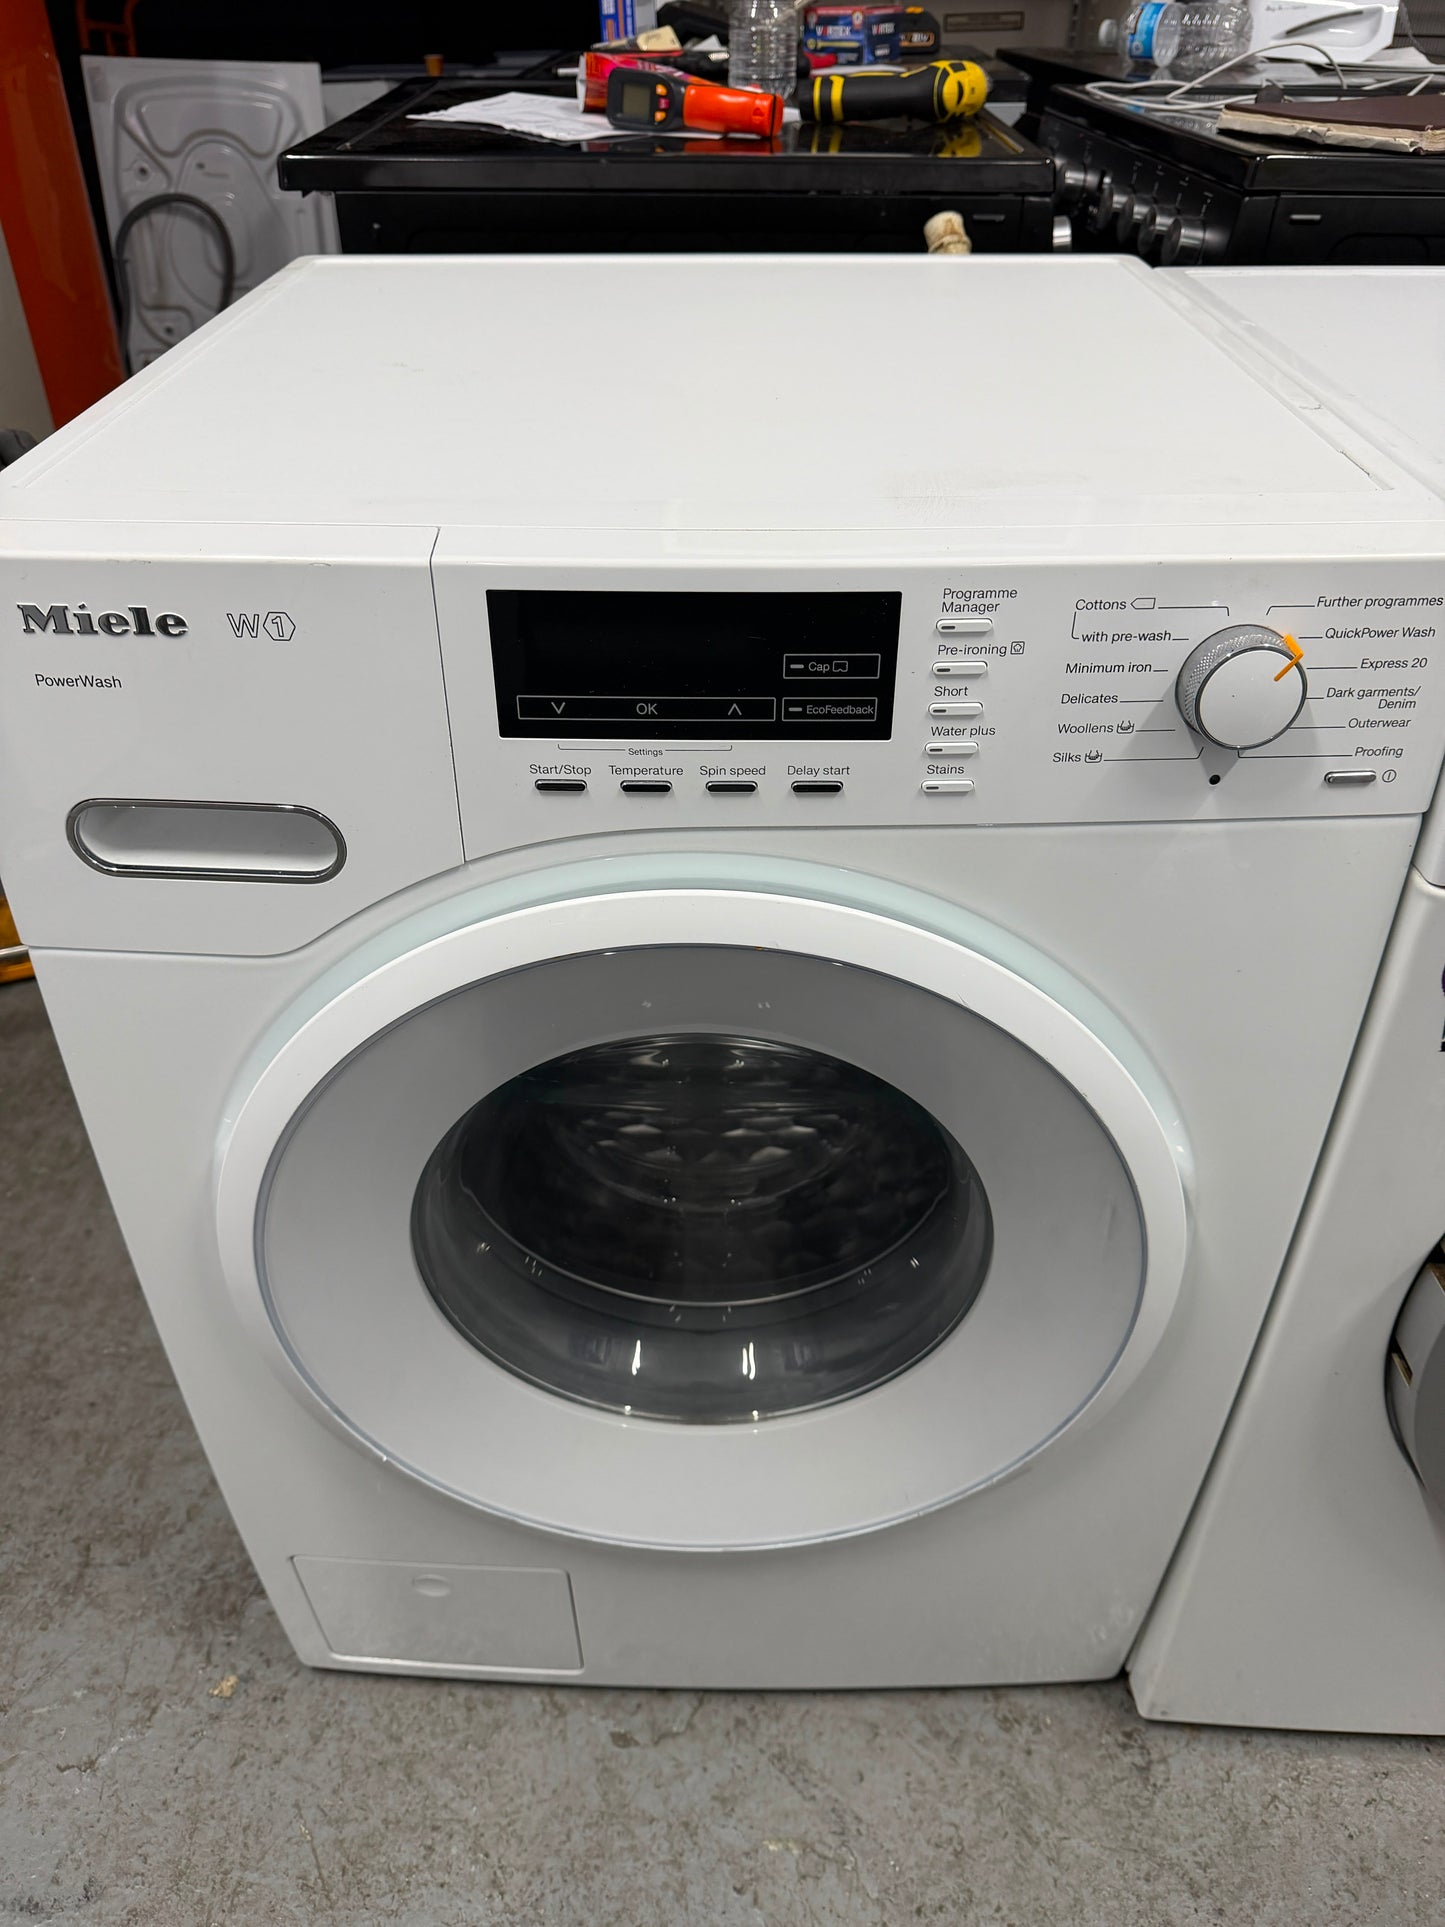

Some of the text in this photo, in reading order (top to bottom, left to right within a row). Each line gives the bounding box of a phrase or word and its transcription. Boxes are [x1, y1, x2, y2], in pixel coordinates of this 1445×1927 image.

[943, 588, 1018, 600] Programme
[941, 602, 1000, 615] Manager
[1075, 599, 1127, 611] Cottons
[1317, 596, 1444, 609] Further programmes
[17, 602, 188, 637] Miele
[1082, 631, 1172, 644] with pre-wash
[1325, 626, 1436, 639] QuickPower Wash
[937, 645, 1007, 657] Pre-ironing
[808, 661, 830, 673] Cap
[1065, 662, 1152, 674] Minimum iron
[1360, 657, 1428, 671] Express 20
[34, 673, 123, 689] PowerWash
[934, 686, 969, 697] Short
[1326, 685, 1422, 699] Dark garments/
[1060, 693, 1119, 704] Delicates
[1378, 698, 1416, 709] Denim
[635, 703, 658, 715] OK
[806, 704, 874, 715] EcoFeedback
[1057, 723, 1114, 734] Woollens
[1348, 717, 1411, 729] Outerwear
[931, 726, 996, 738] Water plus
[628, 747, 664, 757] Settings
[1052, 752, 1082, 763] Silks
[1354, 746, 1403, 758] Proofing
[529, 764, 592, 777] Start/Stop
[609, 765, 683, 777] Temperature
[699, 764, 766, 777] Spin speed
[787, 764, 850, 777] Delay start
[926, 764, 965, 775] Stains
